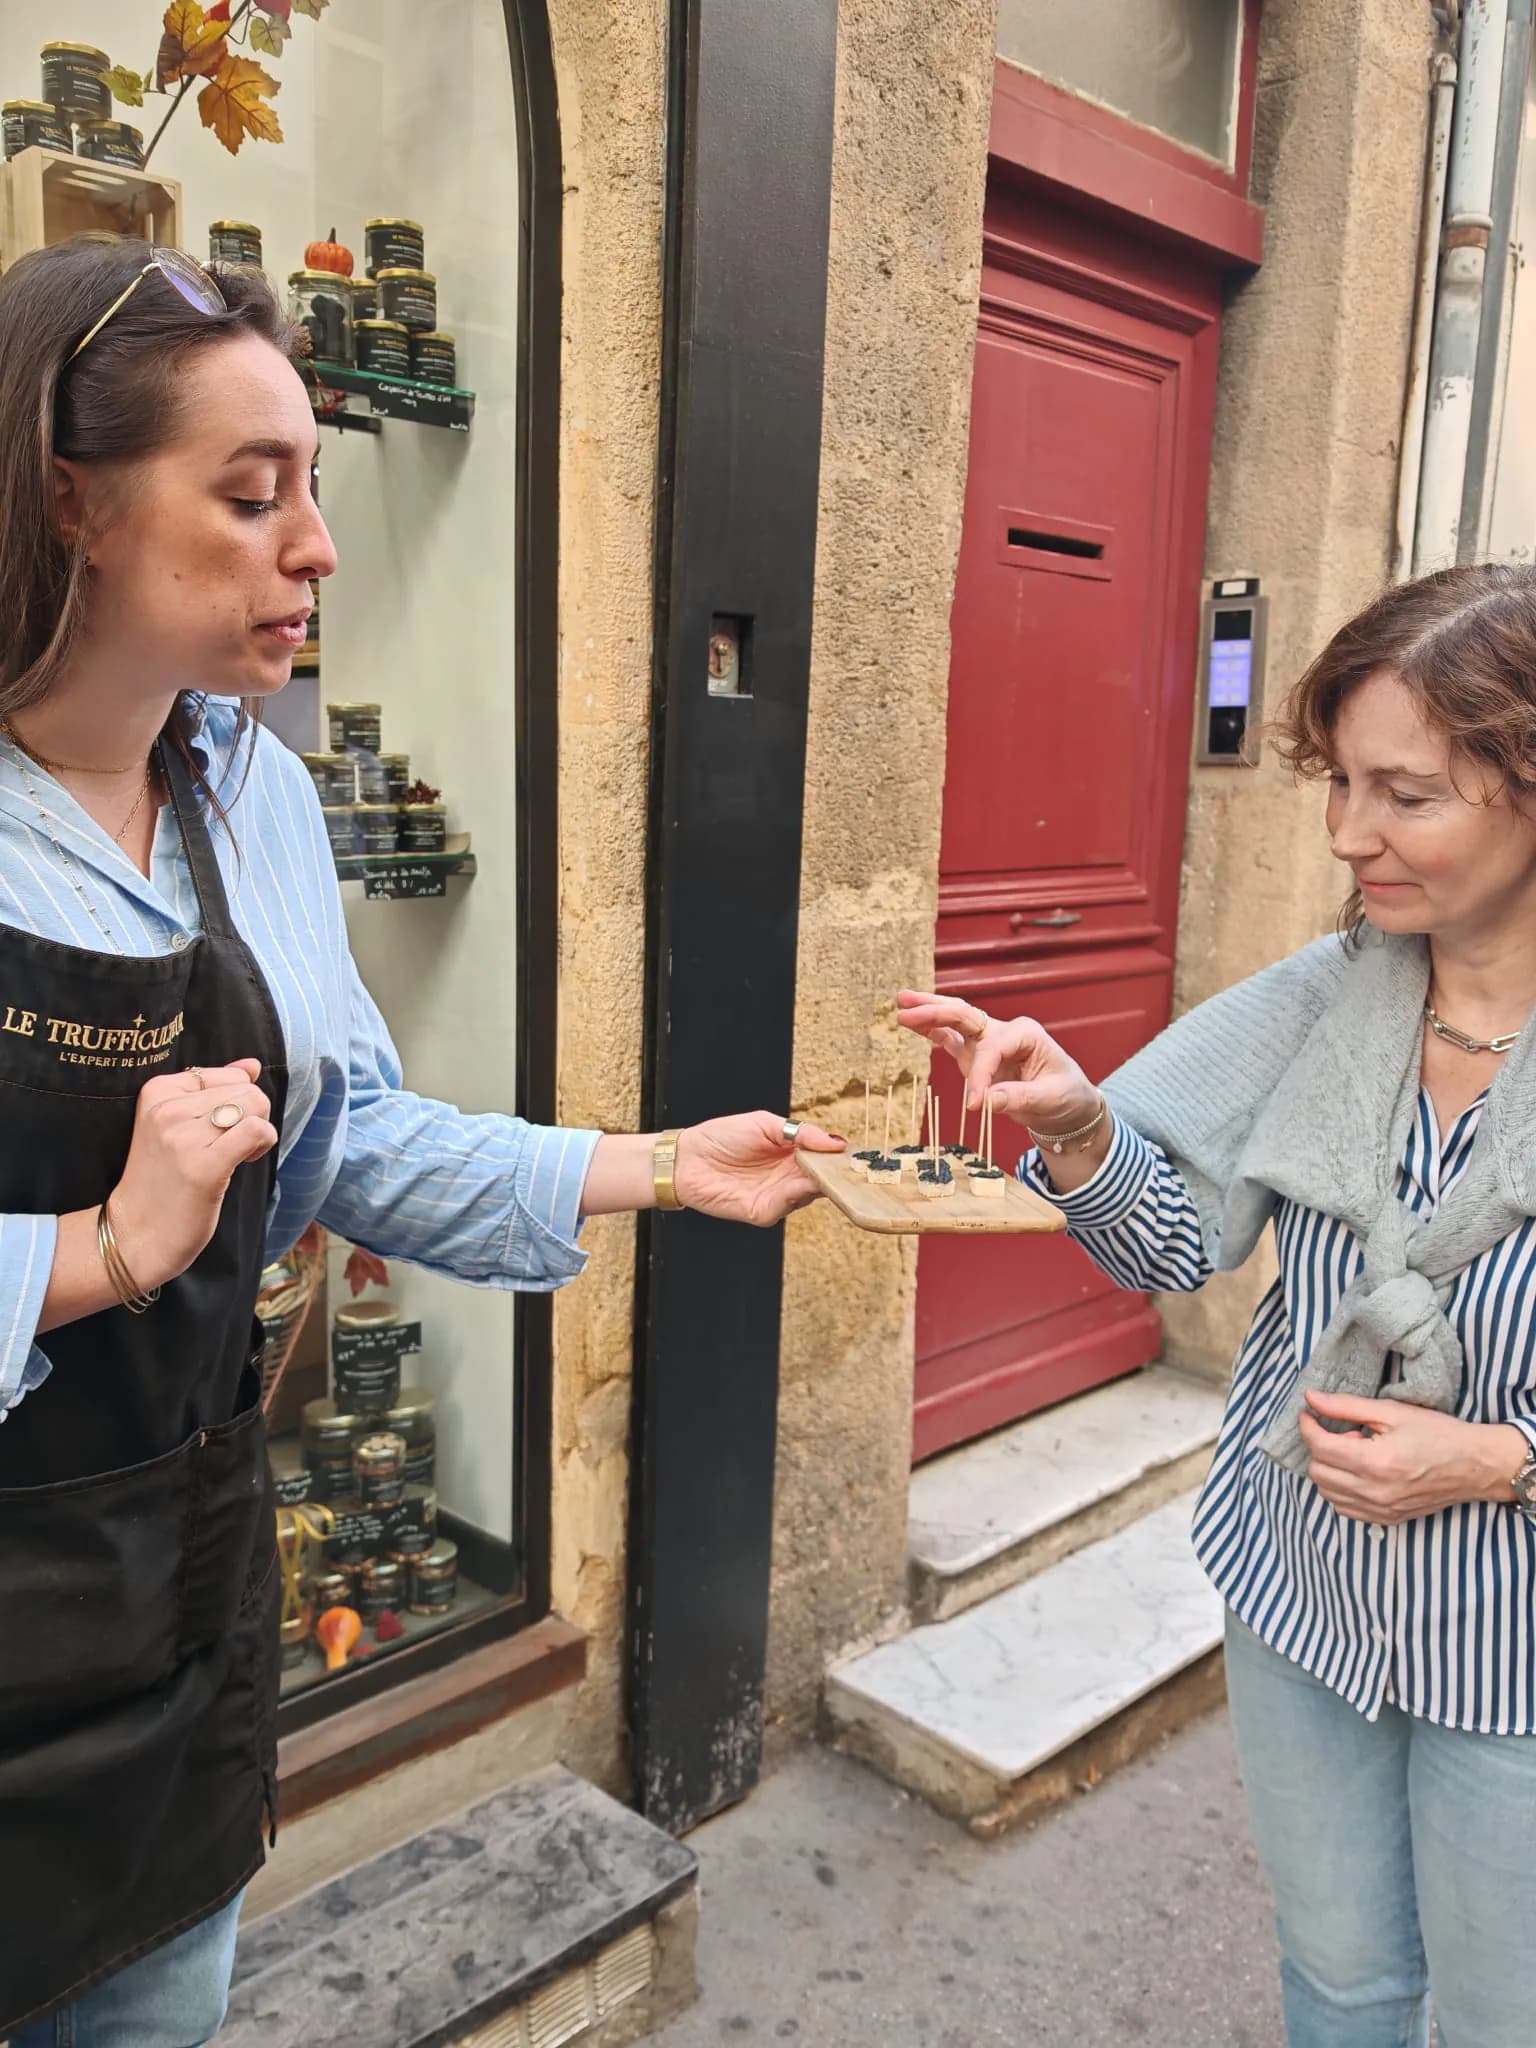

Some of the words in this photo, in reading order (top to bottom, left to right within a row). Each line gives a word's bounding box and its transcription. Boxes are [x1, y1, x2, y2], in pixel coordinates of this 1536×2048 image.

[1, 1006, 38, 1037] LE
[59, 1051, 118, 1068] L'EXPERT
[121, 1057, 135, 1068] DE
[136, 1055, 148, 1067] LA
